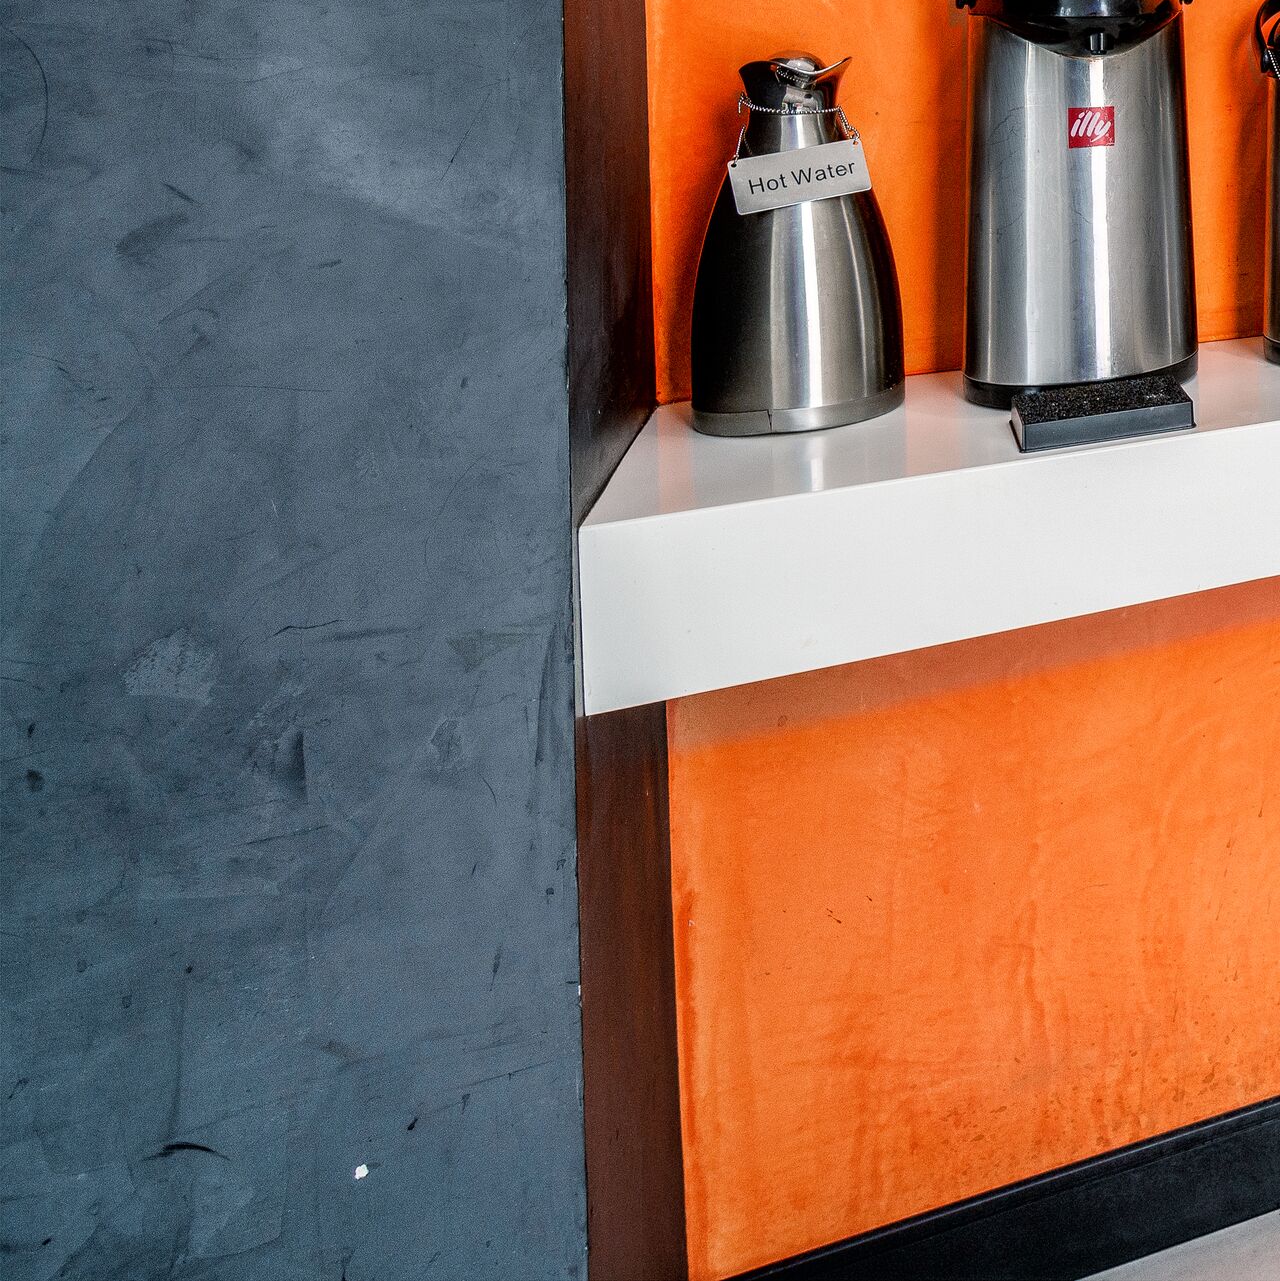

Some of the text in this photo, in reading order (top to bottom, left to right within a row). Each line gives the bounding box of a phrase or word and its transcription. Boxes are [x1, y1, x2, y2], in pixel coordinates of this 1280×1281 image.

[1071, 110, 1111, 142] illy
[748, 161, 856, 195] Hot Water
